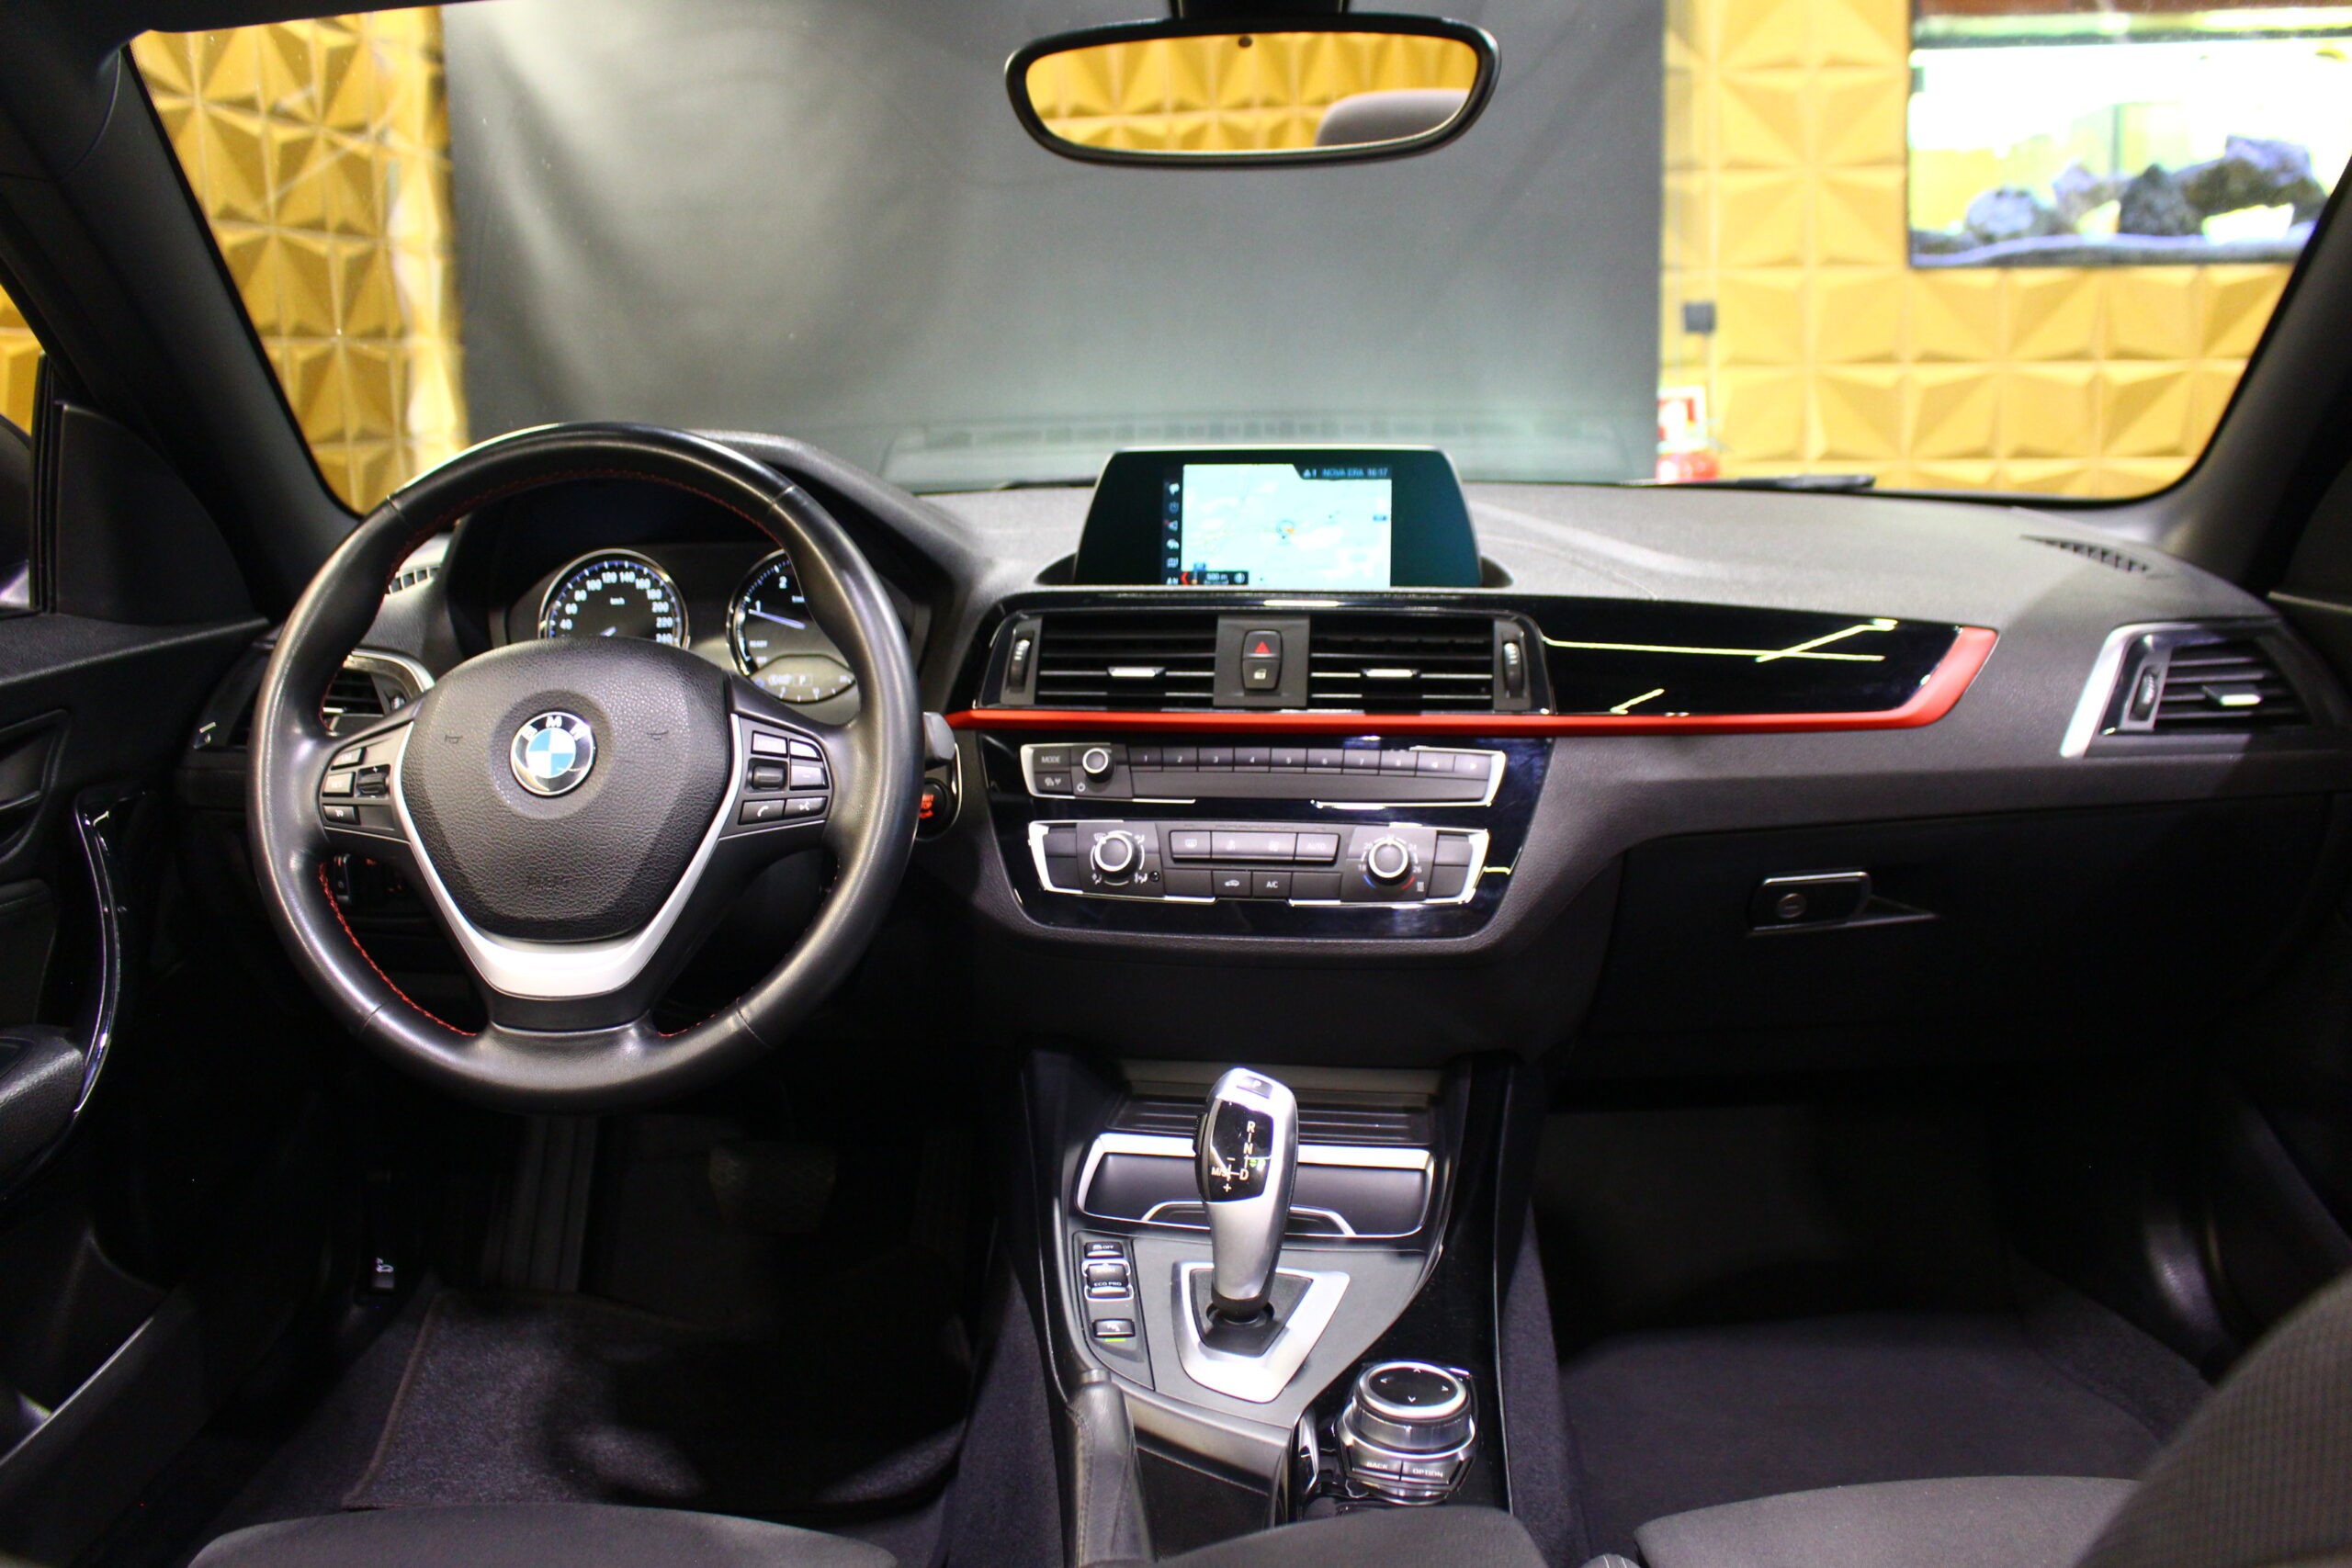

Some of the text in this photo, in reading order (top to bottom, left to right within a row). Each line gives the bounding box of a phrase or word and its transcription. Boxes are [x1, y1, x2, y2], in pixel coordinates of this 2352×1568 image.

[601, 571, 617, 583] 120
[619, 570, 636, 583] 140
[778, 576, 787, 589] 2
[586, 579, 603, 591] 100
[574, 589, 587, 602] 80
[565, 603, 578, 615] 60
[651, 601, 670, 613] 200
[560, 618, 573, 630] 40
[656, 616, 673, 628] 220
[1041, 755, 1060, 763] MODE
[1143, 754, 1148, 762] 1
[1177, 755, 1183, 763] 2
[1213, 755, 1220, 764] 3
[1250, 756, 1256, 764] 4
[1306, 842, 1327, 852] AUTO
[1266, 880, 1279, 889] A/C
[1247, 1120, 1257, 1133] R
[1243, 1142, 1253, 1155] N
[1239, 1168, 1250, 1180] D
[1366, 1461, 1388, 1470] BACK
[1412, 1468, 1443, 1478] OPTION
